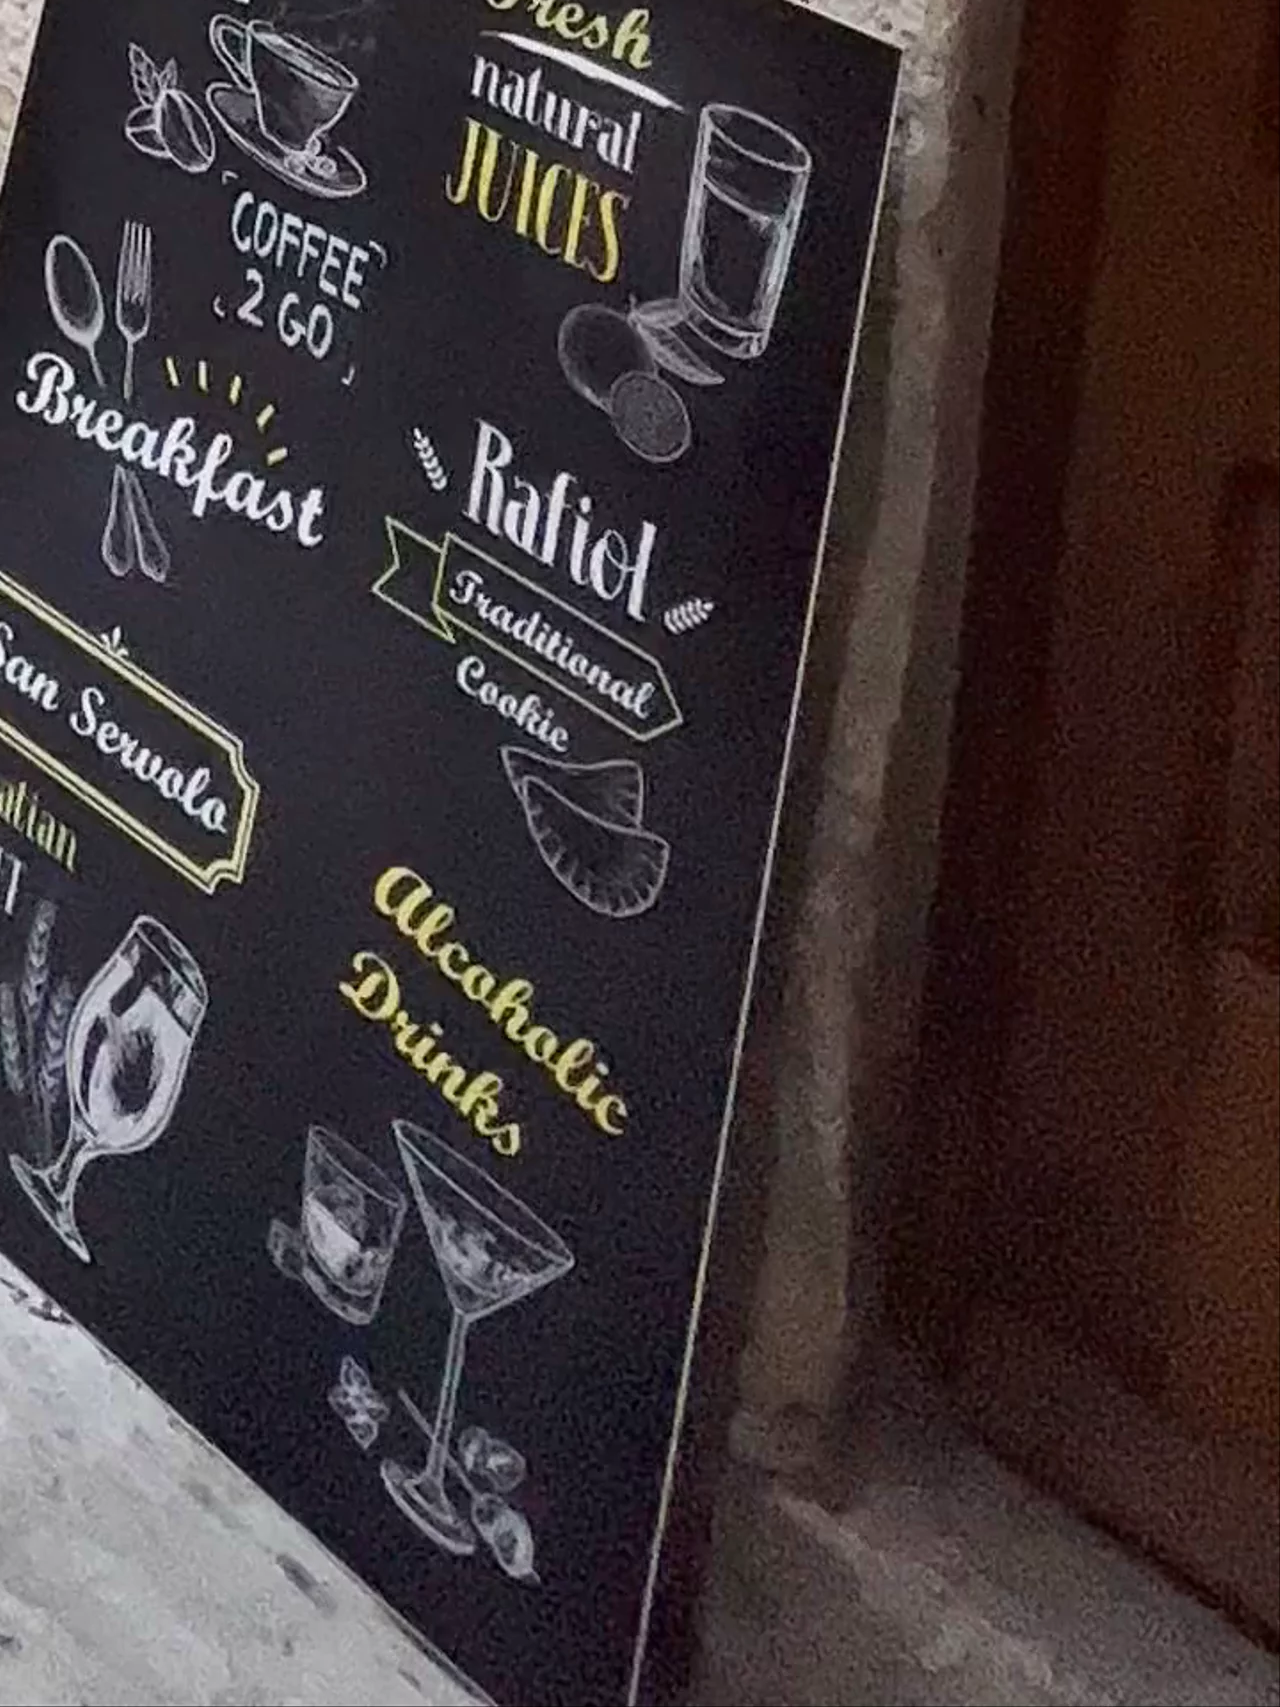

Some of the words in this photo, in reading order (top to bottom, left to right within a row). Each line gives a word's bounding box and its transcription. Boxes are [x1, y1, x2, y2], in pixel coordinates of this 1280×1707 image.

[469, 54, 642, 175] natural
[231, 190, 370, 310] COFFEE
[444, 115, 633, 283] JUICES
[237, 268, 266, 328] 2
[277, 291, 334, 360] GO
[15, 351, 326, 548] Breakfast
[461, 417, 658, 623] Rafiol
[448, 569, 657, 720] Traditional
[455, 655, 571, 753] Cookie
[69, 686, 229, 835] Servolo
[338, 951, 521, 1158] Drinks
[374, 865, 629, 1137] Alcoholic
